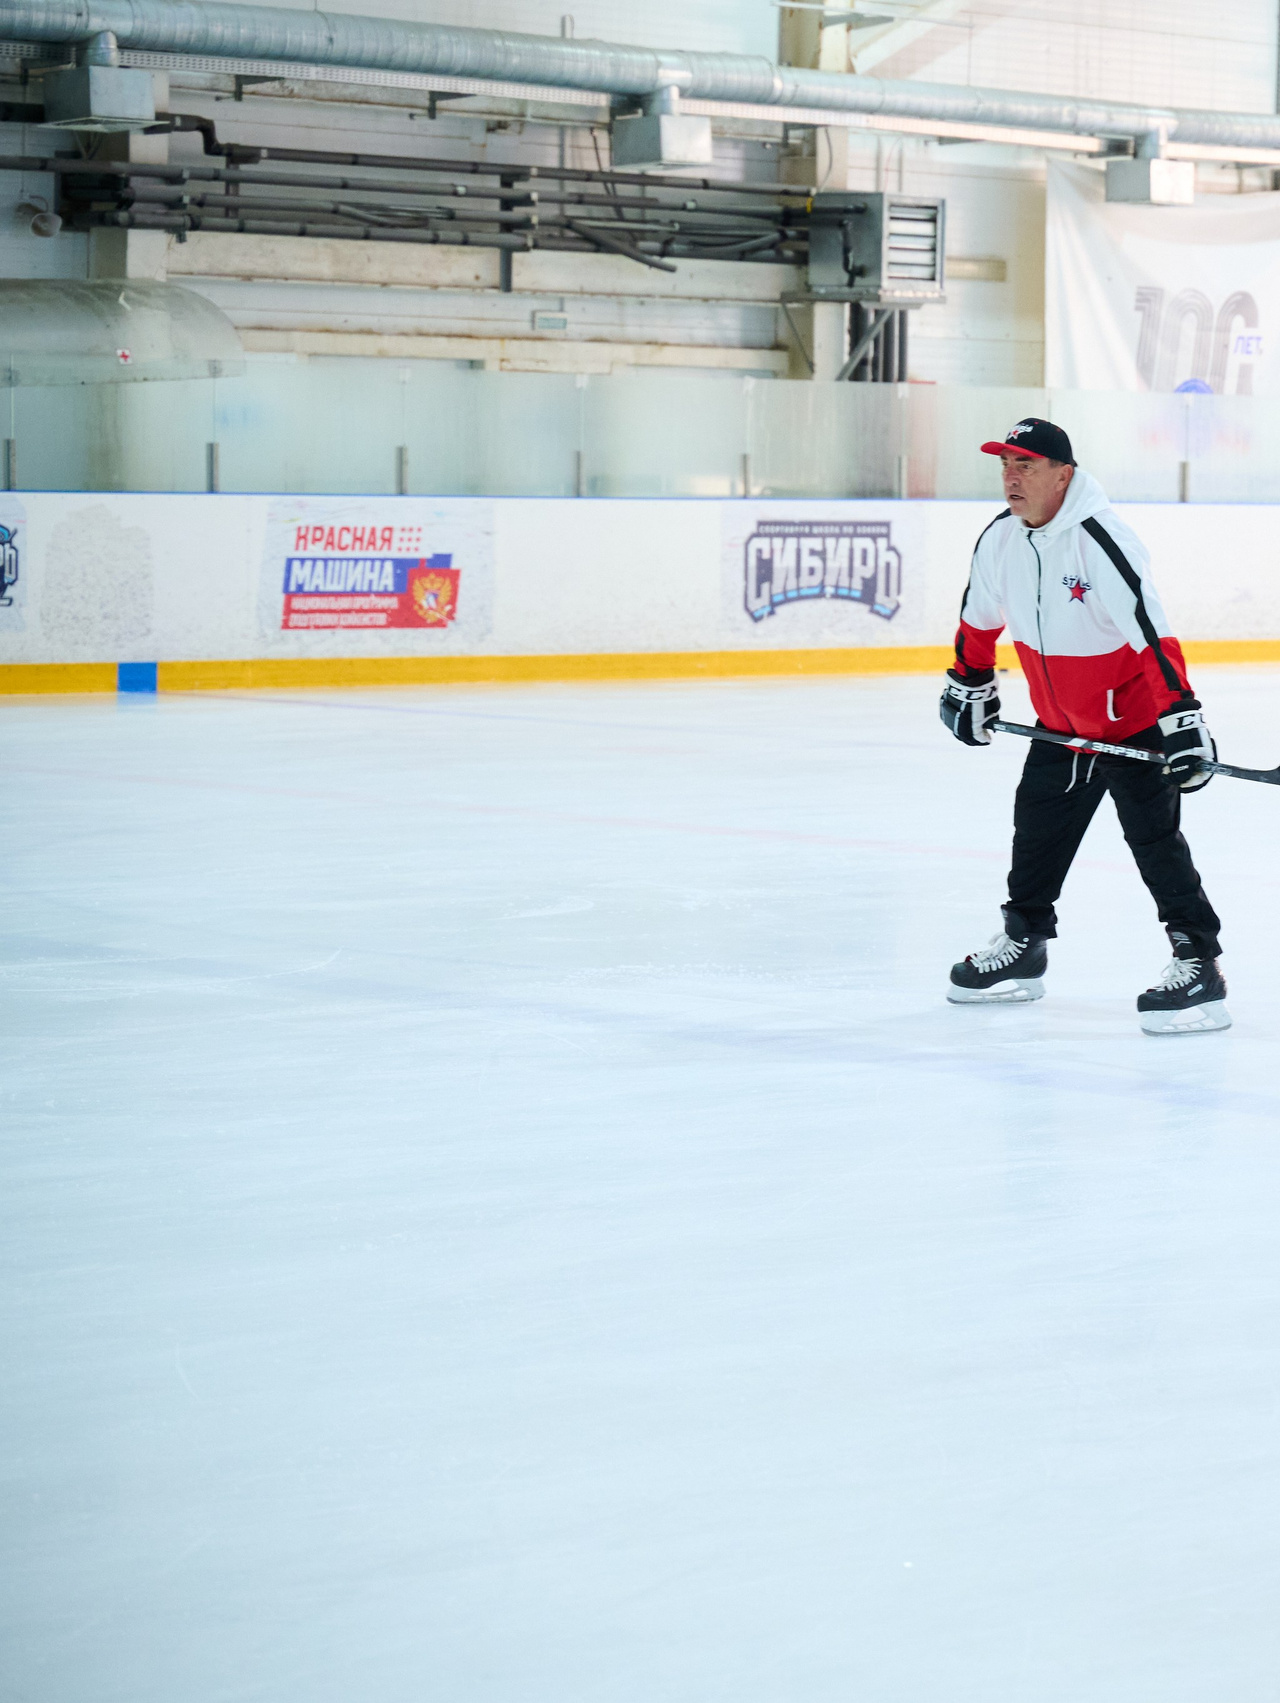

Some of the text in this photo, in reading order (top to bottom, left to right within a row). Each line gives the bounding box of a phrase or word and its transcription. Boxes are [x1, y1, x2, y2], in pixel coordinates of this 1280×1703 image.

[295, 526, 394, 551] КРАСНАЯ
[289, 560, 395, 592] МАШИНА
[746, 536, 900, 617] СИБИРЬ
